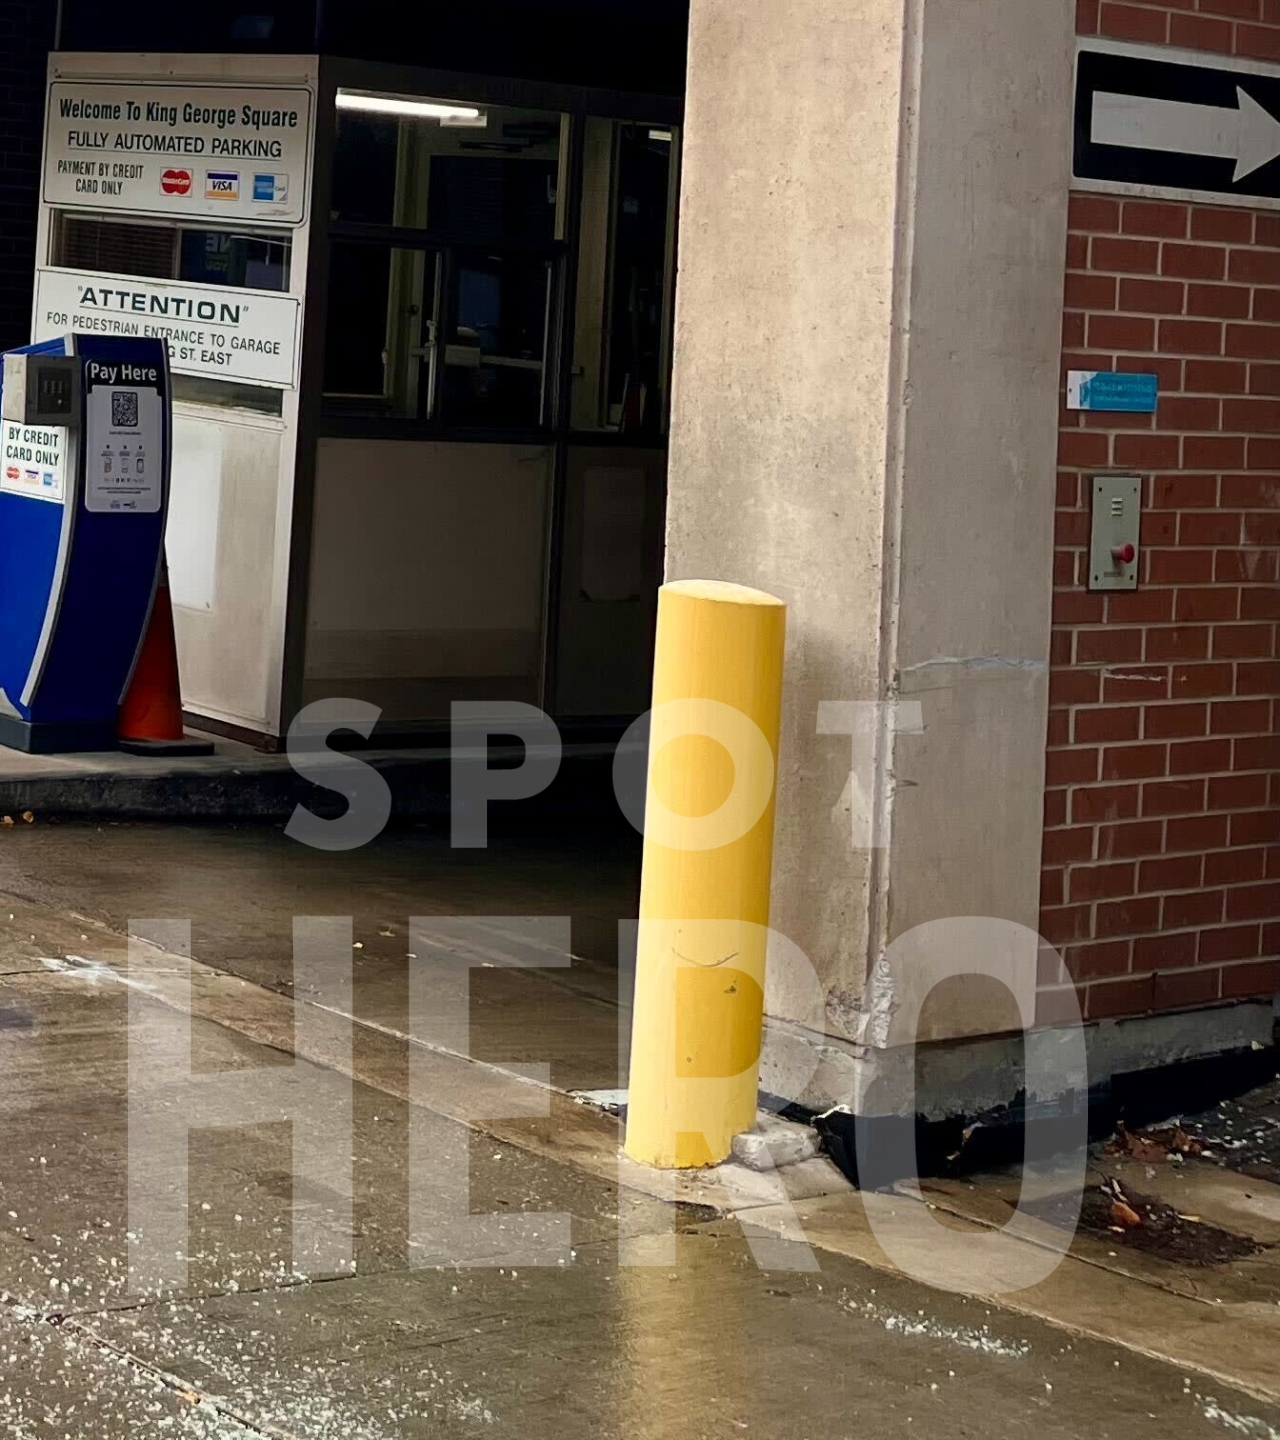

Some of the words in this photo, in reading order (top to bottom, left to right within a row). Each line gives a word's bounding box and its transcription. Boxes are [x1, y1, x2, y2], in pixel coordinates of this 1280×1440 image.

[59, 98, 121, 120] Welcome
[126, 101, 141, 121] To
[146, 101, 178, 127] King
[182, 102, 236, 129] George
[241, 105, 298, 131] Square
[68, 130, 109, 148] FULLY
[114, 133, 205, 153] AUTOMATED
[211, 138, 282, 158] PARKING
[58, 159, 96, 176] PAYMENT
[98, 162, 110, 177] BY
[113, 163, 144, 179] CREDIT
[75, 178, 98, 194] CARD
[101, 180, 123, 195] ONLY
[212, 180, 233, 191] VISA
[47, 311, 68, 326] FOR
[72, 315, 139, 336] PEDESTRIAN
[144, 325, 205, 345] ENTRANCE
[210, 333, 225, 348] TO
[230, 336, 281, 355] GARAGE
[179, 347, 197, 360] ST.
[201, 350, 233, 366] EAST
[91, 363, 118, 384] Pay
[121, 364, 157, 381] Here
[9, 426, 21, 441] BY
[24, 429, 59, 448] CREDIT
[6, 445, 32, 462] CARD
[35, 449, 60, 467] ONLY
